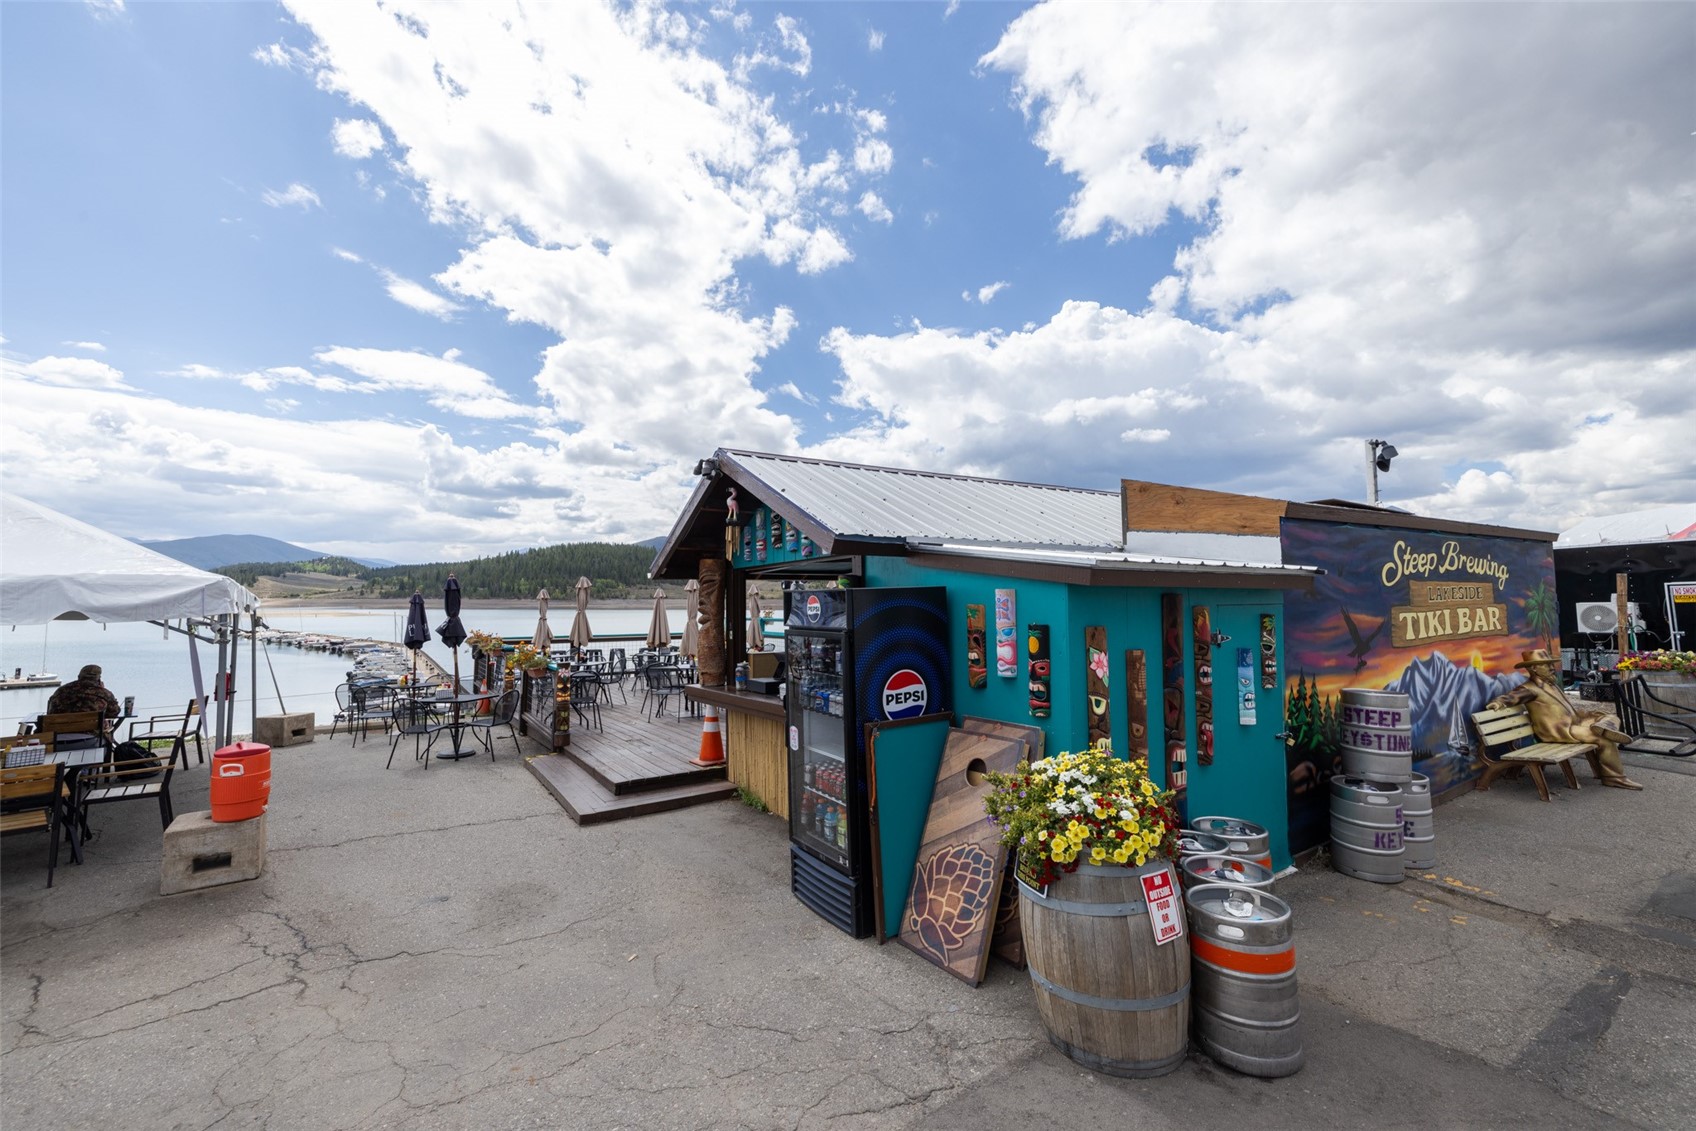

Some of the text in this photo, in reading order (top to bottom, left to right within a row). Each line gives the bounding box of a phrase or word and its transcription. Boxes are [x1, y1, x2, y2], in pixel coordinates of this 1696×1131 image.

[1382, 540, 1509, 590] Steep Brewing
[1427, 585, 1483, 602] LAKESIDE
[1674, 587, 1682, 595] NO
[1399, 606, 1502, 640] TIKI BAR
[885, 690, 925, 706] PEPSI
[1343, 706, 1402, 728] STEEP
[1153, 875, 1162, 886] NO
[1149, 885, 1171, 900] OUTSIDE
[1156, 900, 1170, 911] FOOD
[1161, 913, 1170, 923] OR
[1161, 924, 1176, 937] DRINK
